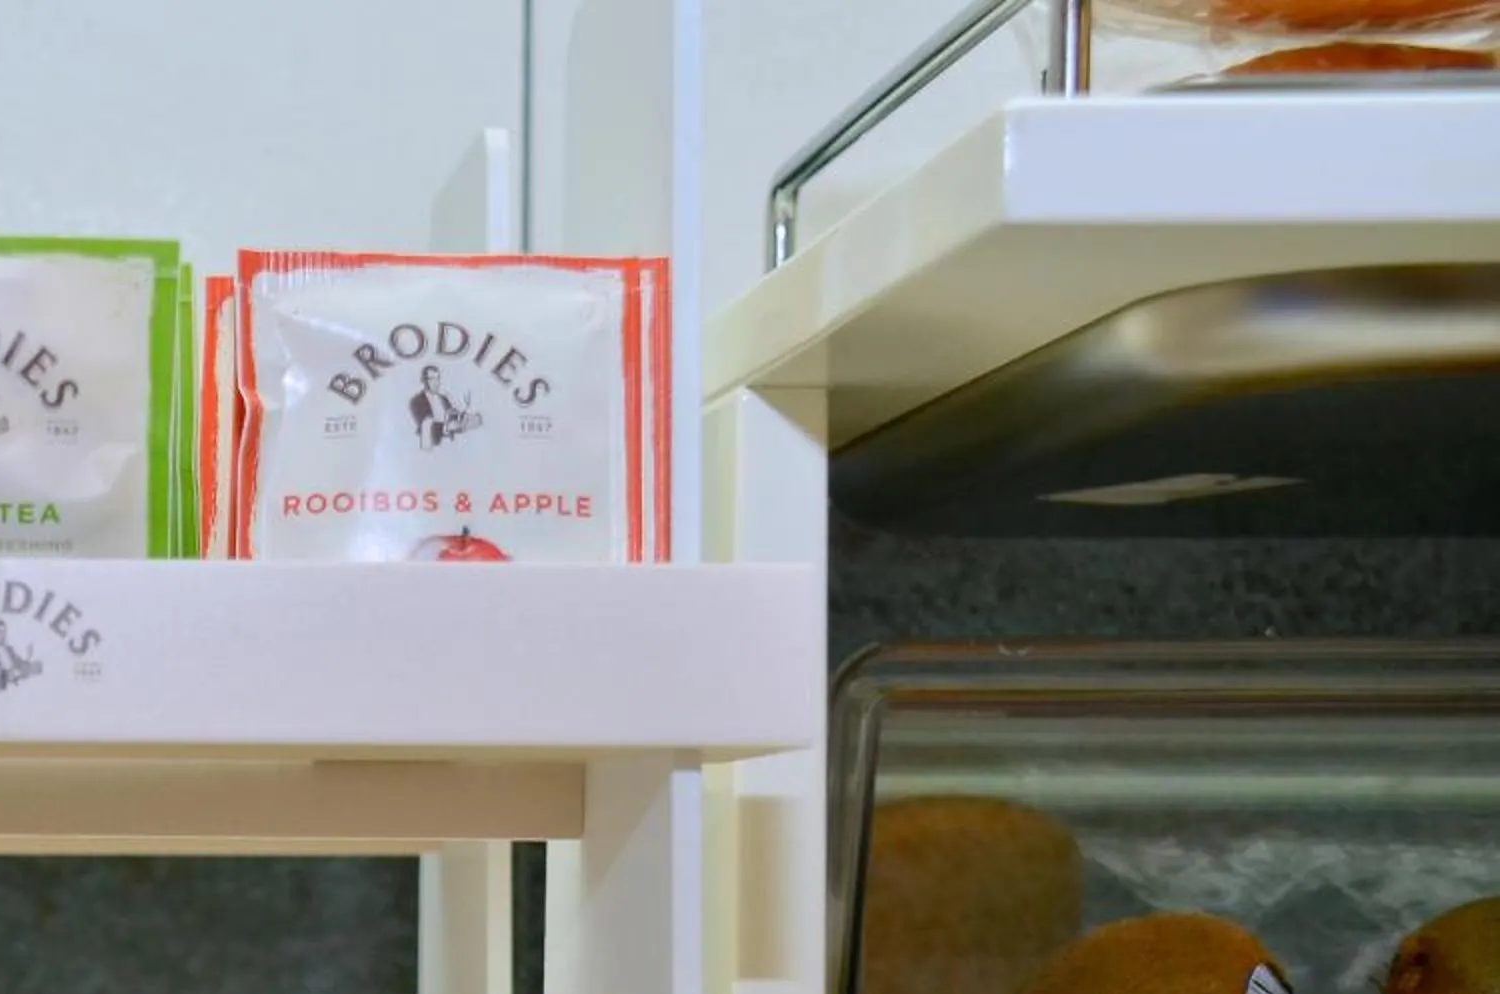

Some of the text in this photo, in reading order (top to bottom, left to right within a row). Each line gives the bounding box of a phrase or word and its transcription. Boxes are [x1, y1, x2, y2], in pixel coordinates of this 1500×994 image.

[328, 321, 550, 407] BRODIES
[282, 491, 593, 518] ROOIBOS & APPLE
